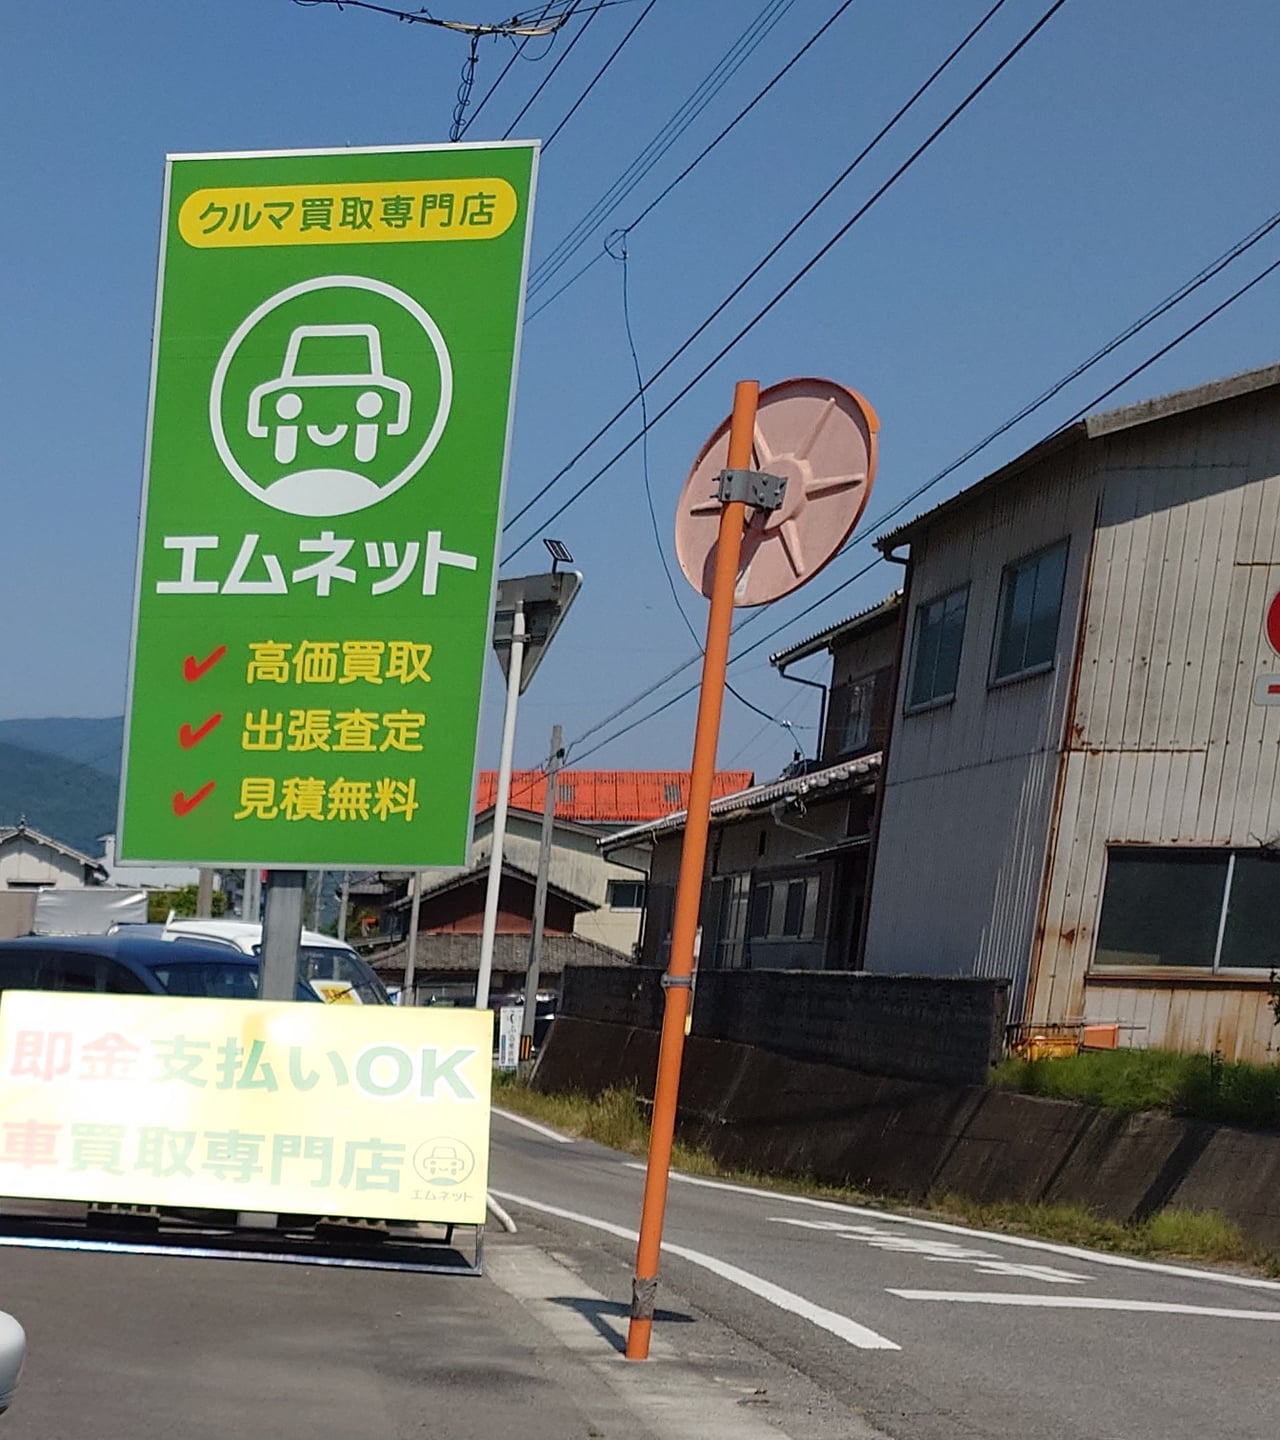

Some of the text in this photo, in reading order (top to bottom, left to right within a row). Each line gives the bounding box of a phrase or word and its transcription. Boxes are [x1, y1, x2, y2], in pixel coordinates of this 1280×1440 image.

[197, 191, 498, 236] クルマ買取専門店
[156, 530, 478, 597] エムネット
[245, 640, 433, 686] 高価買取
[240, 710, 427, 754] 出張査定
[233, 777, 420, 822] 見積無料
[9, 1029, 478, 1100] 即金支払いOK
[410, 1189, 473, 1202] エムネット
